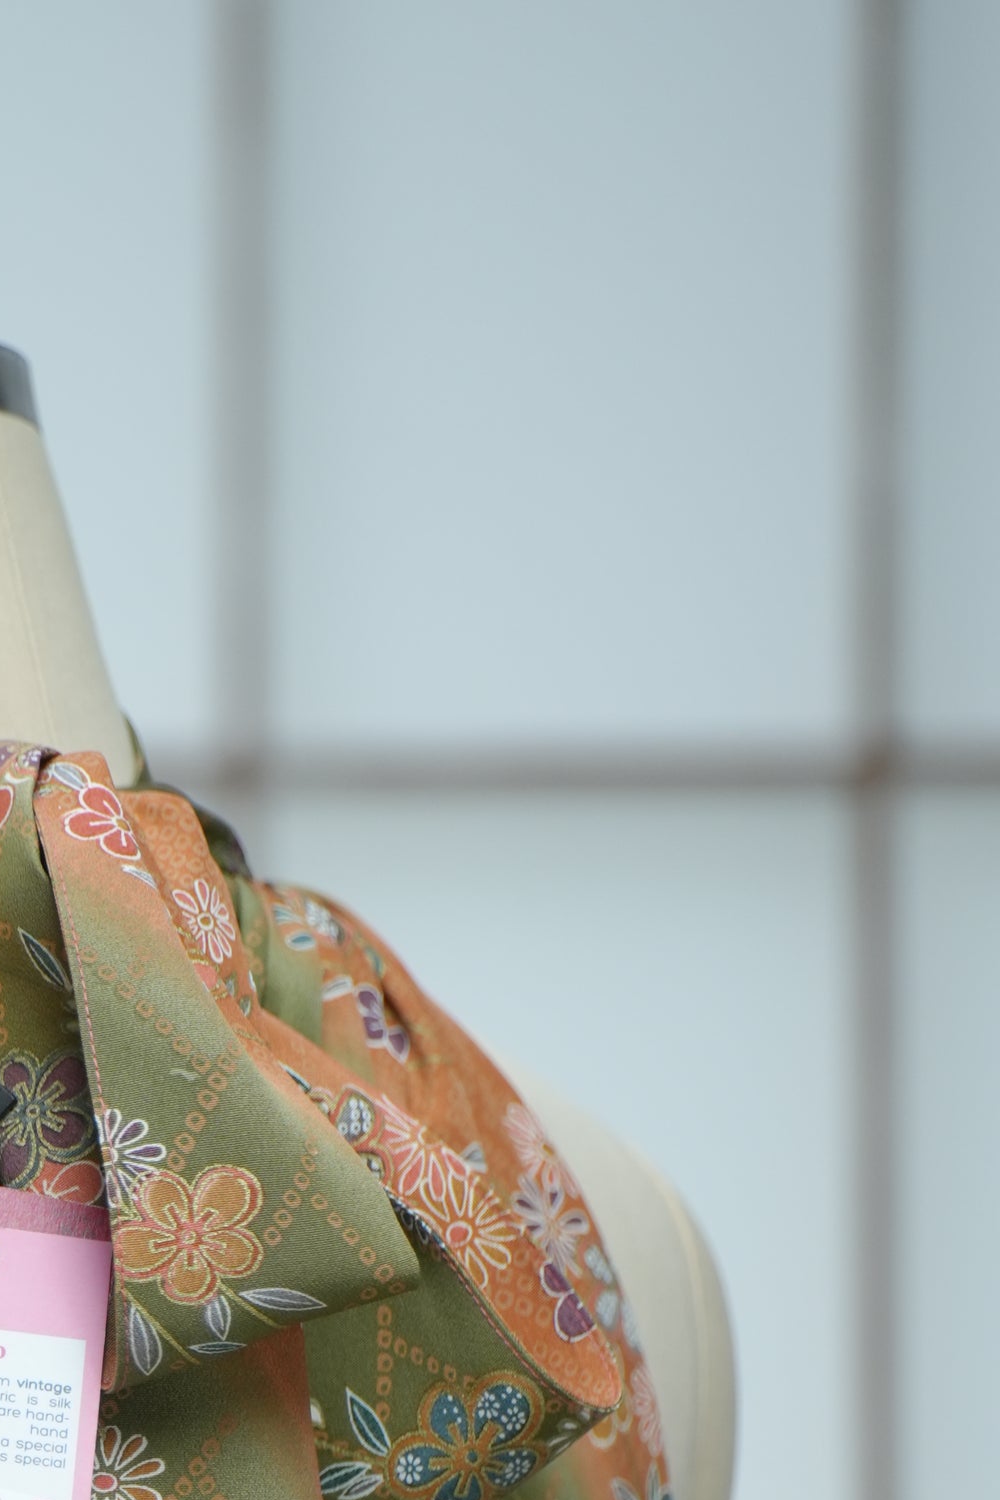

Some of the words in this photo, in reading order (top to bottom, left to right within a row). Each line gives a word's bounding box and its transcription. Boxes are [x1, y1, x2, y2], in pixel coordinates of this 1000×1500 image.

[16, 1378, 72, 1395] vintage
[27, 1394, 38, 1406] is
[49, 1397, 71, 1409] silk
[25, 1408, 70, 1423] hand-
[30, 1424, 68, 1439] hand
[0, 1438, 10, 1447] a
[16, 1439, 67, 1454] special
[14, 1453, 66, 1469] special
